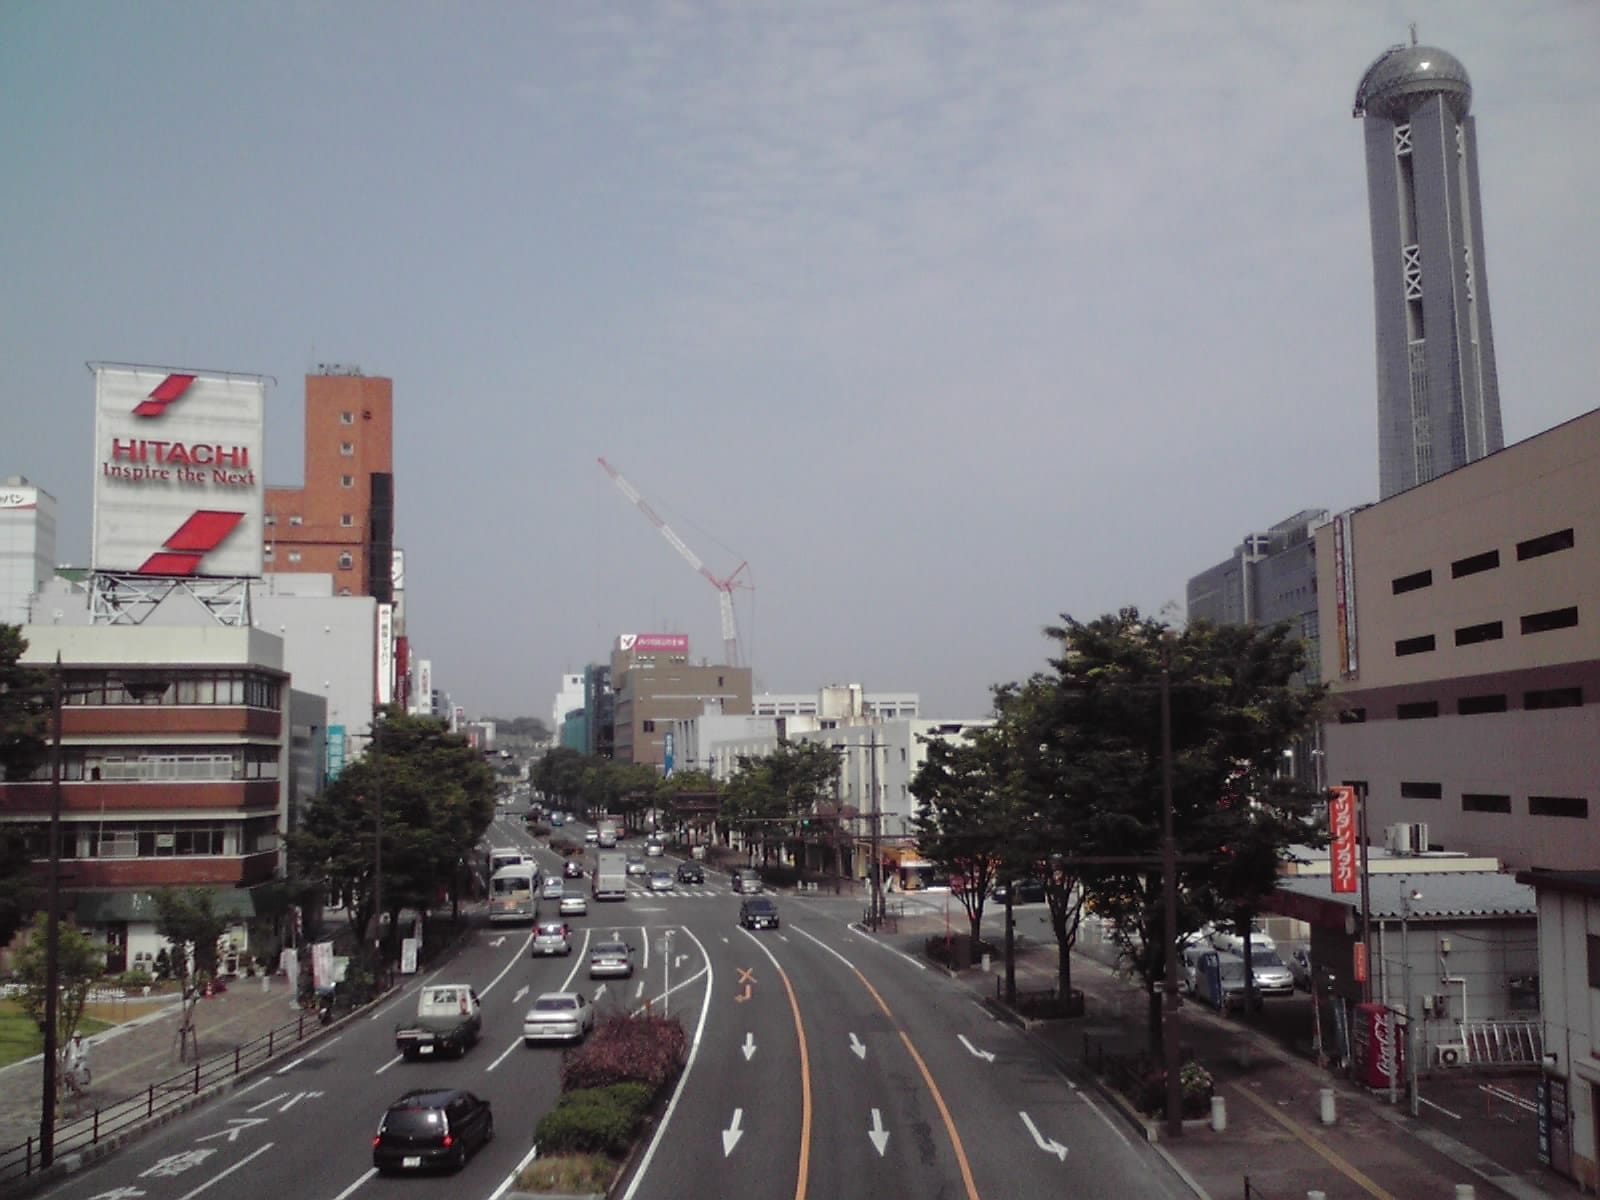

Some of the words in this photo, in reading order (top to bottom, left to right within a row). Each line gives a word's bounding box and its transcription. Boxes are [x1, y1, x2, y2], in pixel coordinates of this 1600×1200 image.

[112, 438, 249, 469] HITACHI
[103, 462, 169, 484] Inspire
[177, 466, 204, 483] the
[212, 469, 256, 486] Next
[1335, 790, 1352, 889] マツダレンタカー
